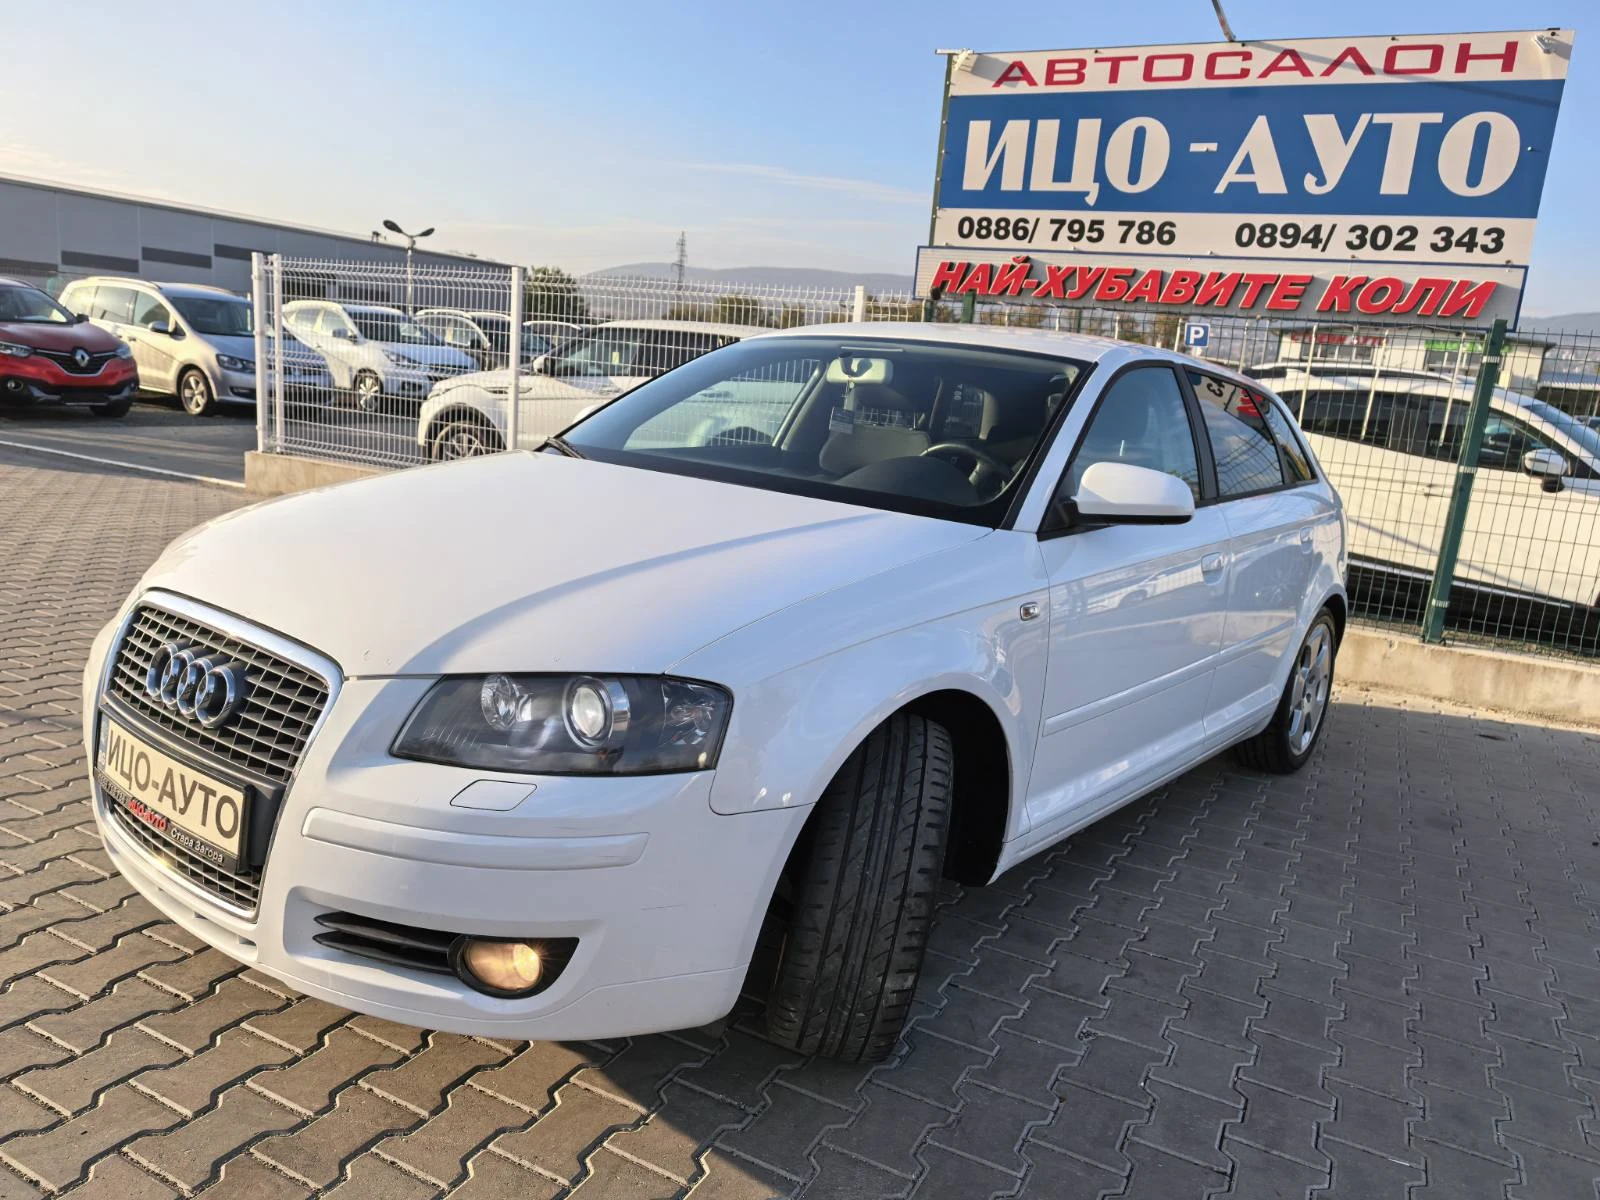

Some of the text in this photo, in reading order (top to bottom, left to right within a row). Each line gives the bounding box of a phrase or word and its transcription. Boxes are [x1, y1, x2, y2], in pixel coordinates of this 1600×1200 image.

[992, 41, 1519, 88] АВТОСАЛОН
[957, 215, 1506, 254] 0886/ 795 786 0894/ 302 343
[931, 255, 1498, 319] НАЙ-ХУБАВИТЕ КОЛИ
[1189, 326, 1205, 345] P
[107, 729, 239, 840] ИЦО-АУТО
[171, 827, 194, 848] Стара
[194, 841, 224, 864] Загора
